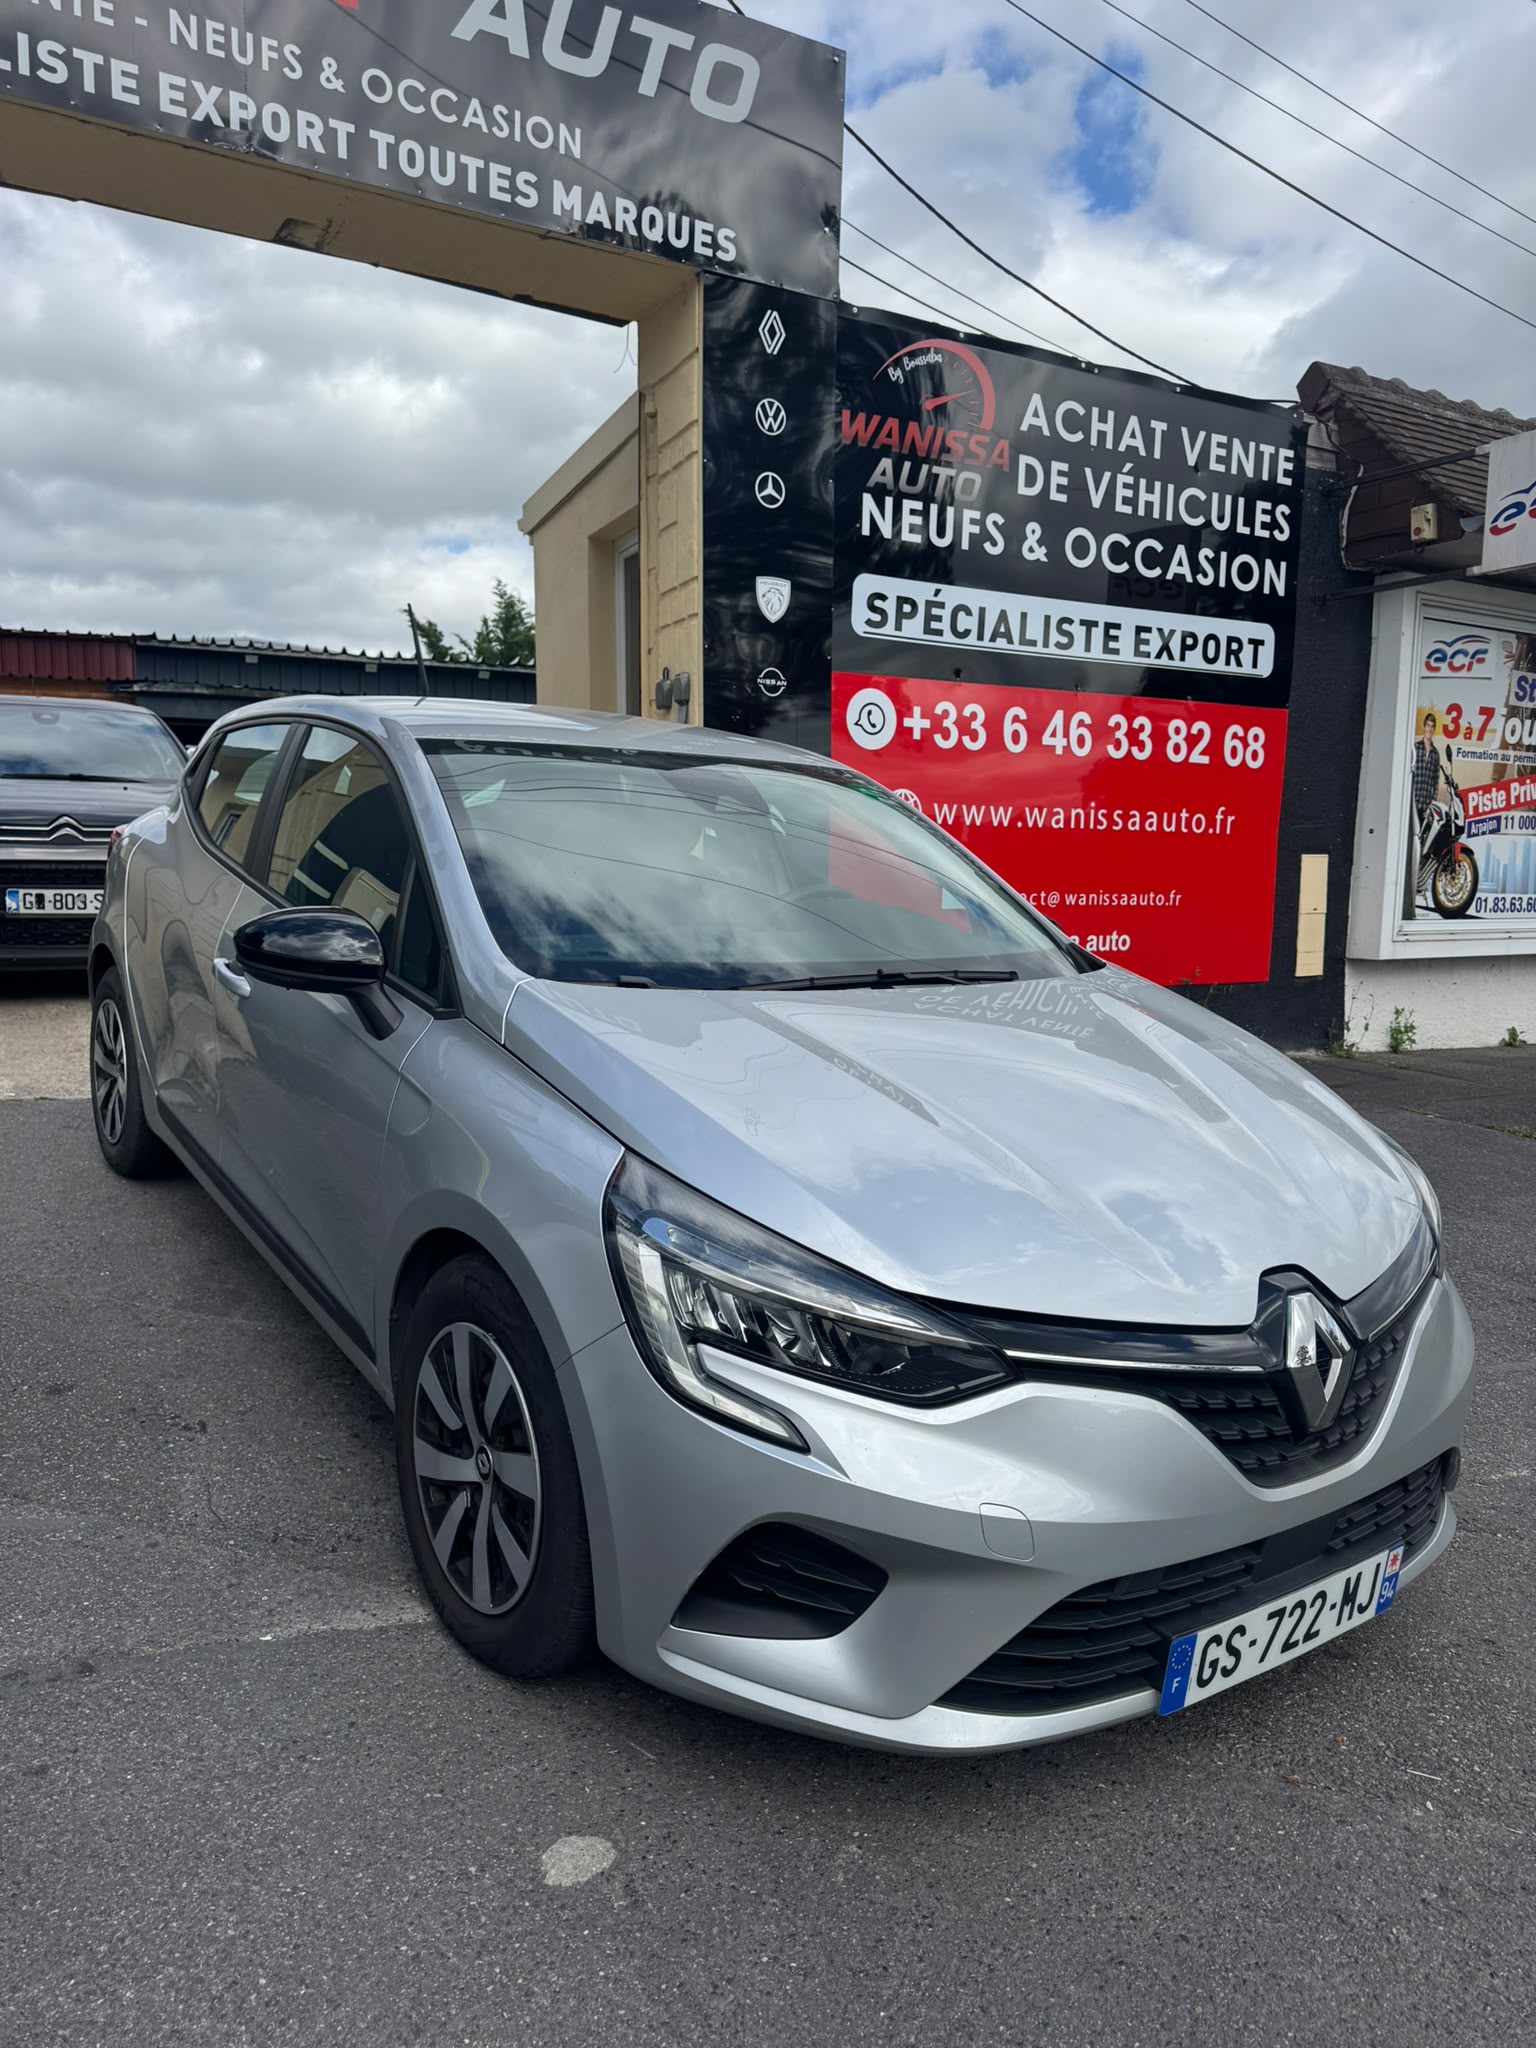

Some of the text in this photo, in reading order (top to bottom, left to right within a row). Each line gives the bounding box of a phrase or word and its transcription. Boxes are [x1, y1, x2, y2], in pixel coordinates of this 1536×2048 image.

[169, 8, 303, 80] NEUFS
[319, 56, 346, 93] &
[361, 67, 582, 159] OCCASION
[450, 0, 760, 124] AUTO
[158, 71, 355, 160] EXPORT
[369, 129, 539, 208] TOUTES
[553, 180, 737, 262] MARQUES
[841, 409, 1010, 472] WANISSA
[1020, 393, 1295, 486] ACHAT VENTE
[866, 457, 982, 500] AUTO
[1017, 453, 1291, 542] DE VÉHICULES
[861, 493, 1287, 597] NEUFS & OCCASION
[865, 589, 1266, 669] SPÉCIALISTE EXPORT
[903, 701, 1266, 769] +33 6 46 33 82 68
[1442, 703, 1463, 739] 3
[1476, 706, 1496, 741] 7
[1456, 747, 1498, 761] Formation
[1501, 753, 1511, 761] au
[933, 801, 1235, 834] www.wanissaauto.fr
[1468, 788, 1506, 816] Piste
[1470, 819, 1497, 836] Arpajon
[1504, 815, 1514, 829] 11
[1065, 889, 1182, 906] wanissaauto.fr
[1085, 930, 1131, 952] auto
[1380, 1577, 1396, 1603] 94
[1196, 1562, 1381, 1689] GS-722-MJ
[1171, 1677, 1181, 1693] F
